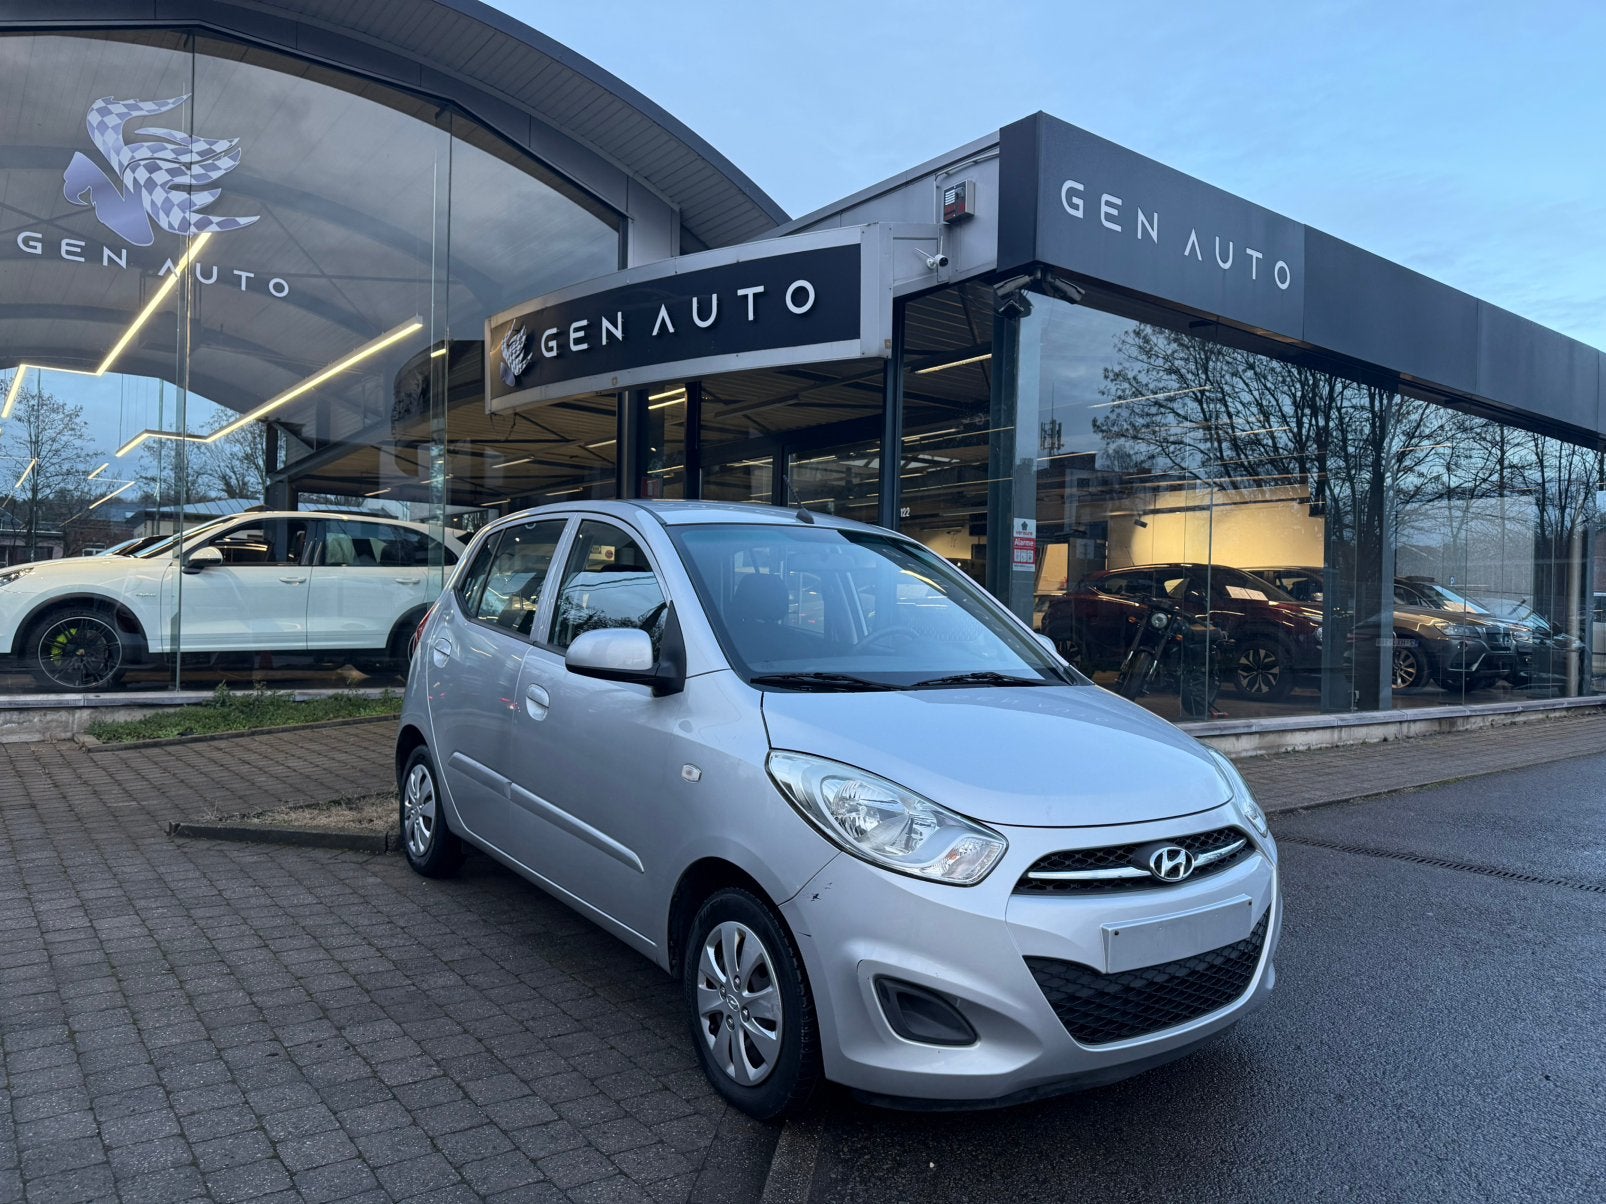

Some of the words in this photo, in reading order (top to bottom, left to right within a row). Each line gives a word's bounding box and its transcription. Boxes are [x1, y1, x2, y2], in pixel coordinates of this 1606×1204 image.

[17, 231, 127, 269] GEN
[158, 258, 289, 298] AUTO
[1061, 179, 1158, 244] GEN
[1184, 228, 1291, 290] AUTO
[540, 311, 624, 358] GEN
[652, 280, 816, 336] AUTO
